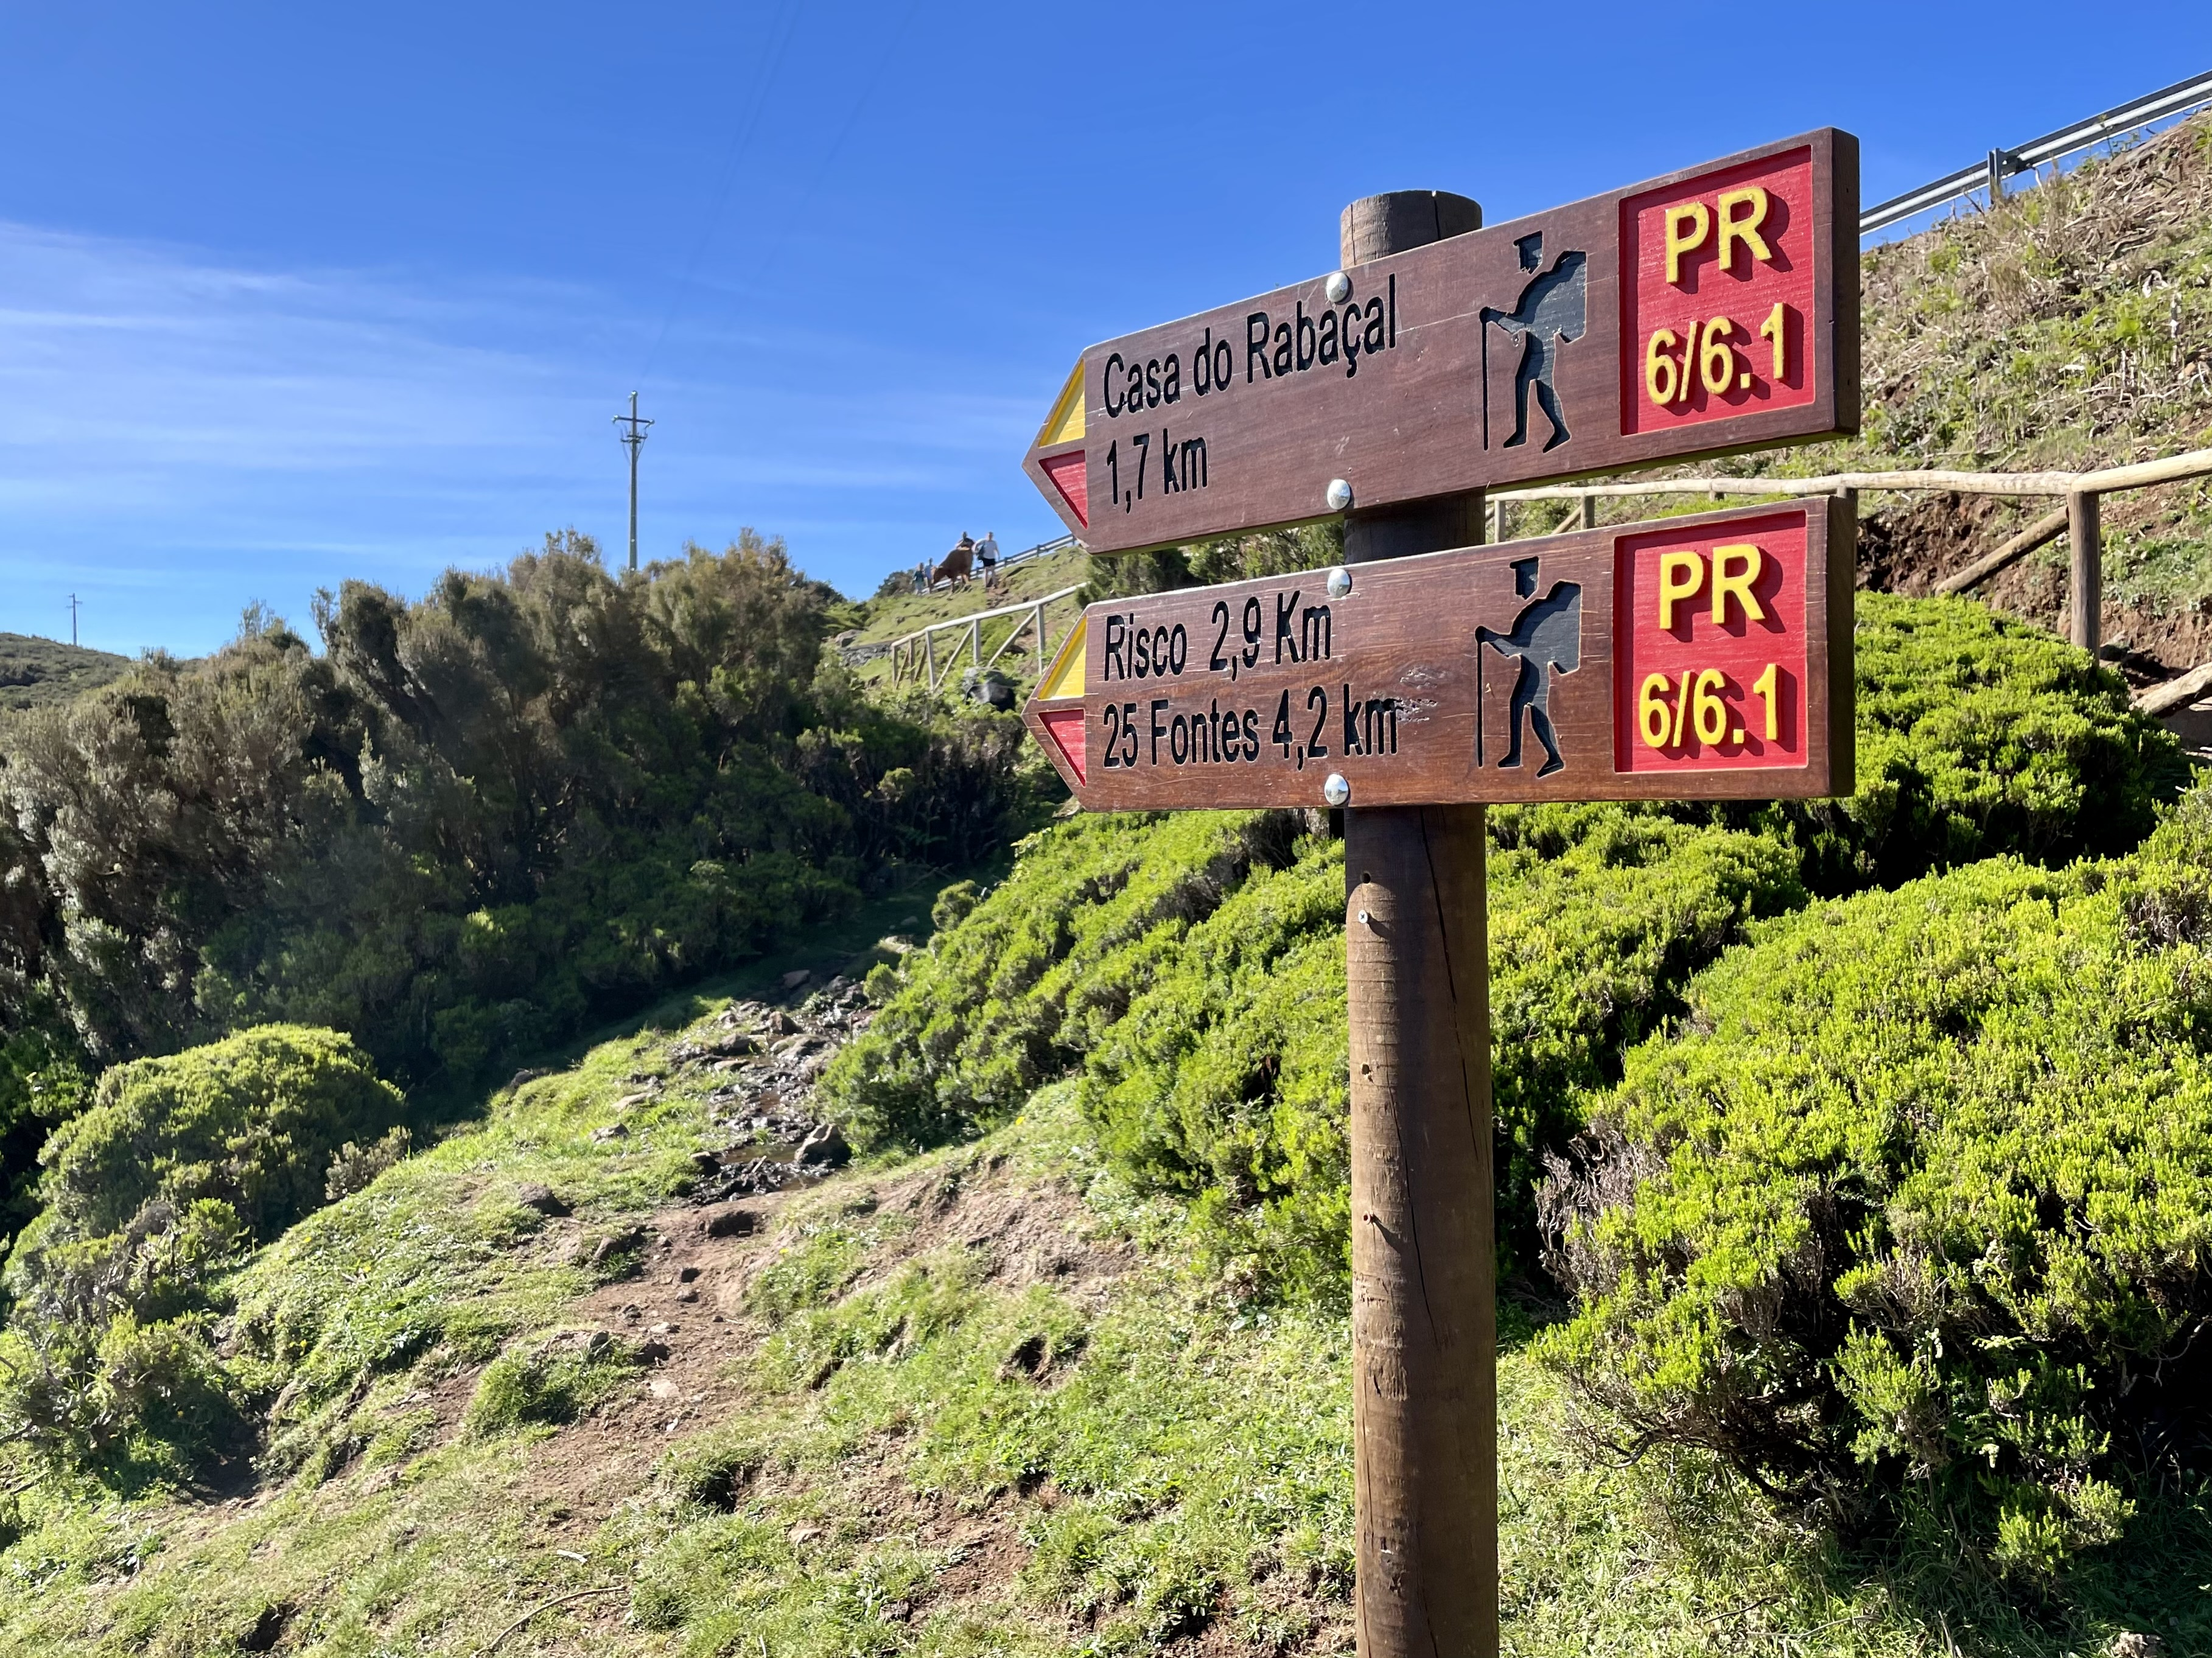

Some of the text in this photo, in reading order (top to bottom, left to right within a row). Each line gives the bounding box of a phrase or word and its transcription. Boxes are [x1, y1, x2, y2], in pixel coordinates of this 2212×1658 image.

[1665, 187, 1772, 283] PR
[1104, 273, 1395, 418] Casa do Rabaçal
[1107, 428, 1208, 514] 1,7 km
[1659, 544, 1765, 629] PR
[1104, 590, 1331, 681] Risco 2,9 Km
[1104, 683, 1398, 771] 25 Fontes 4,2 km
